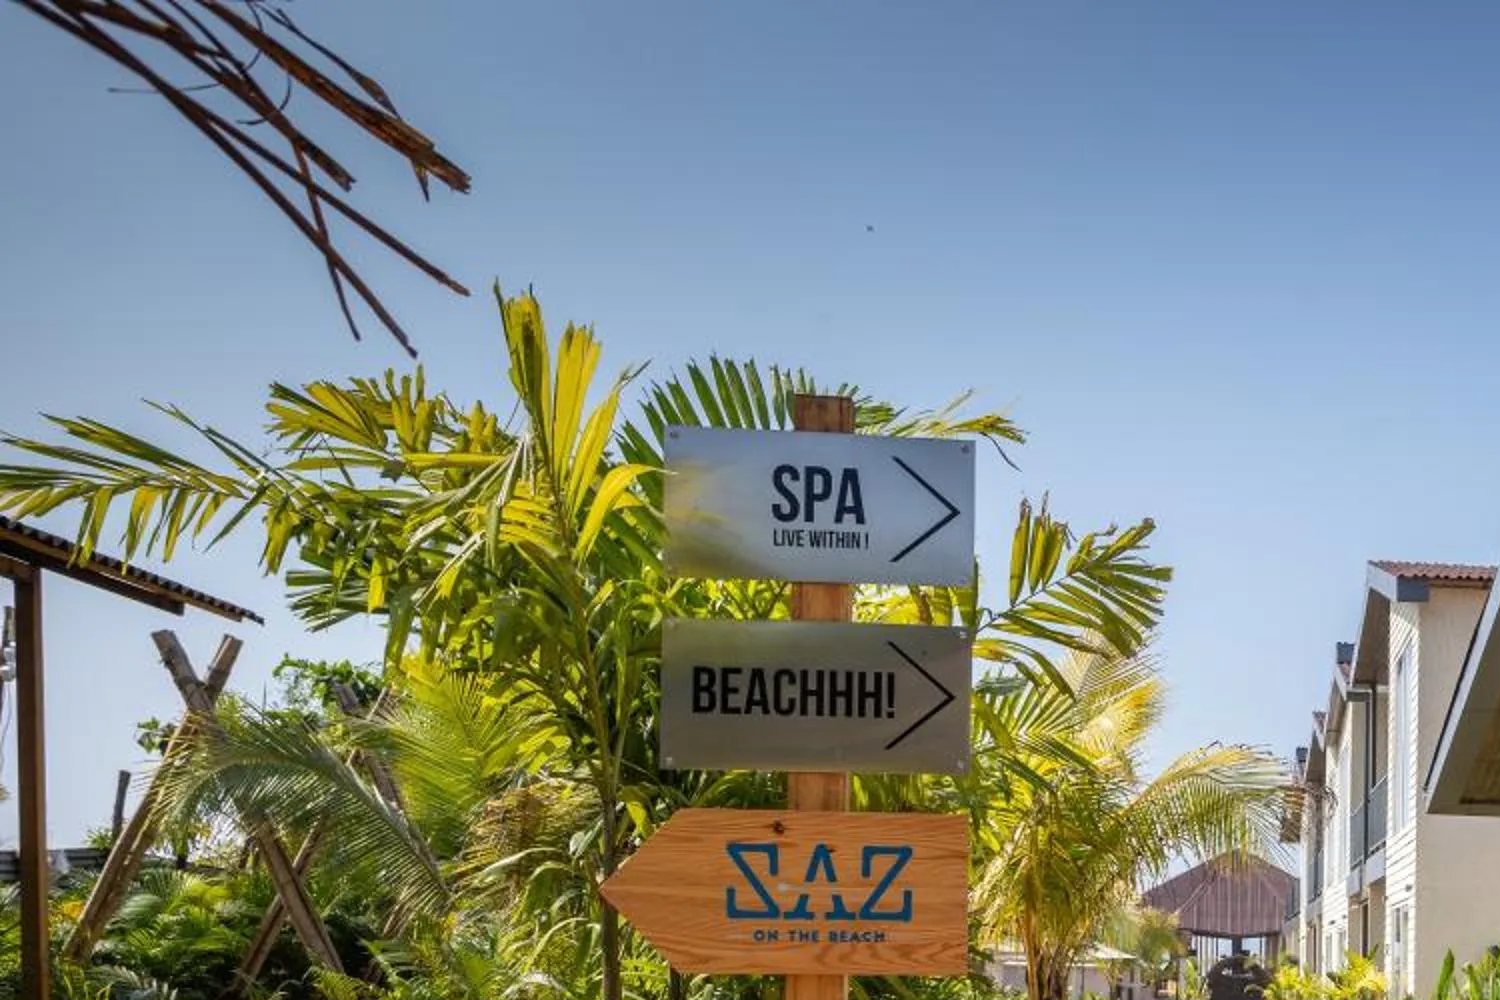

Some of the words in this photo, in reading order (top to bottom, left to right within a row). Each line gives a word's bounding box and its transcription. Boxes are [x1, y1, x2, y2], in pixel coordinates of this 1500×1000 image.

[772, 464, 866, 525] SPA
[773, 528, 805, 547] LIVE
[692, 666, 895, 718] BEACHHH!
[753, 930, 779, 942] ON
[789, 930, 820, 943] THE
[828, 930, 886, 944] BEACH
